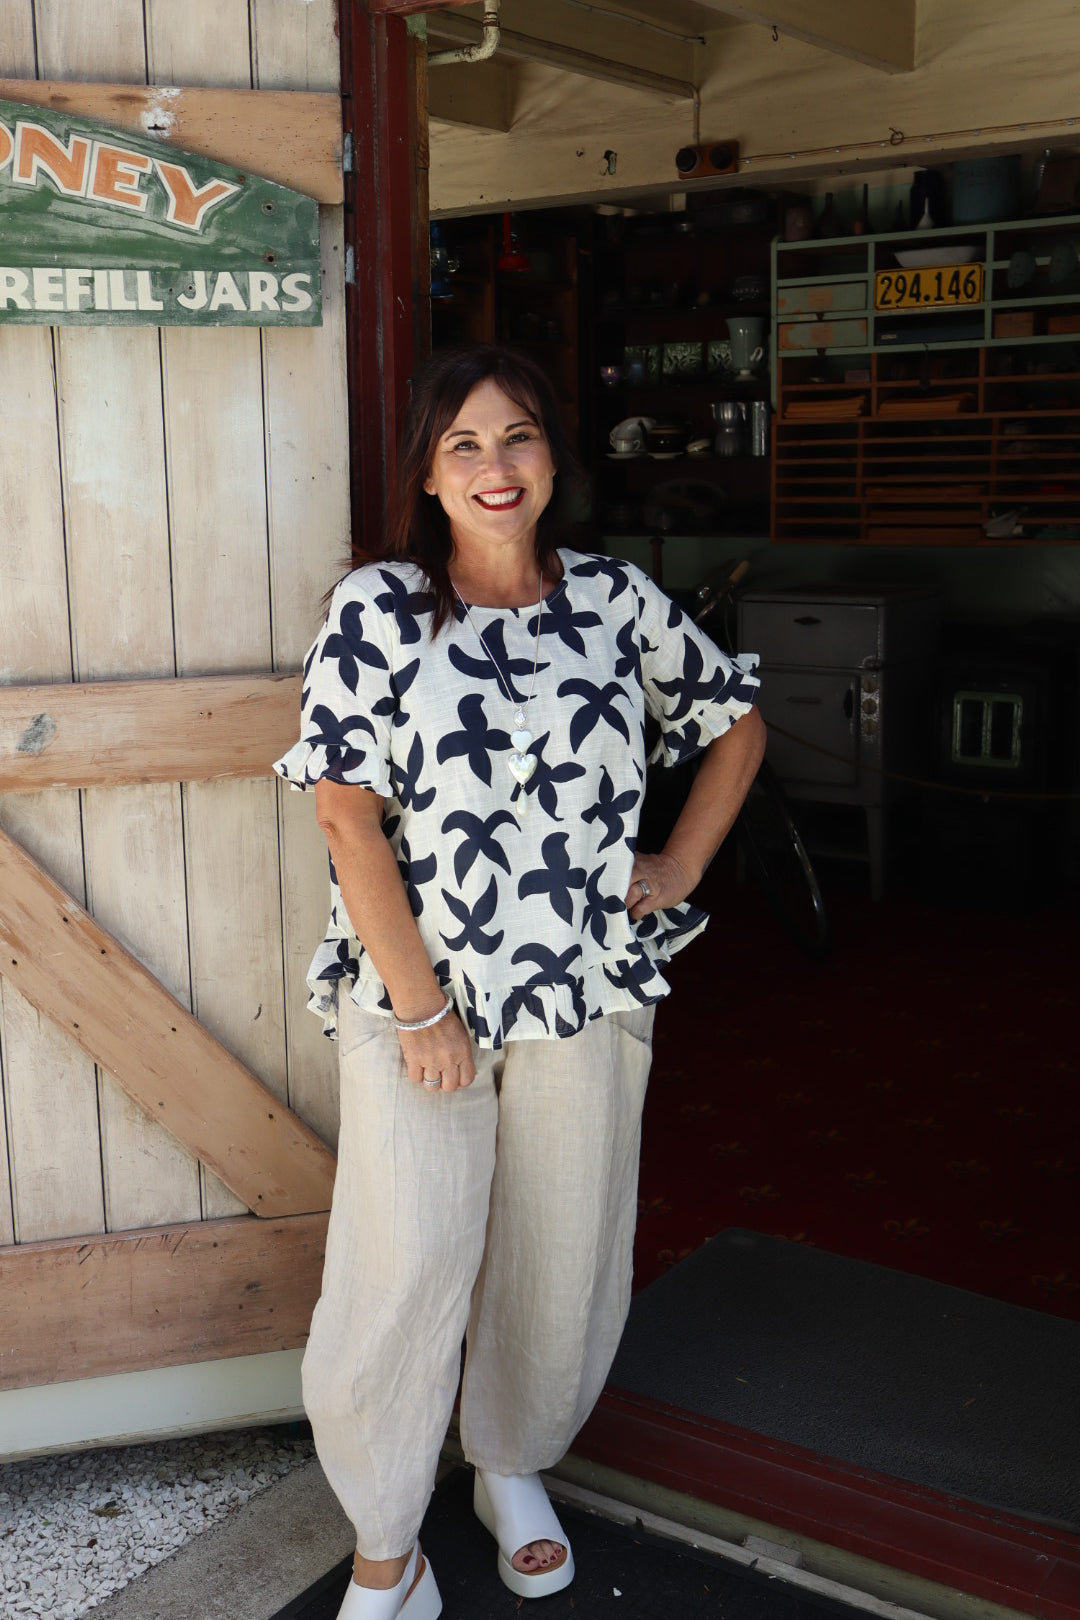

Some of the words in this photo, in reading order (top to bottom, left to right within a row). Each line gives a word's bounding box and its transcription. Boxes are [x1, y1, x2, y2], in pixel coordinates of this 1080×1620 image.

[0, 120, 242, 231] NEY
[0, 266, 163, 311] REFILL
[176, 270, 313, 312] JARS
[880, 269, 977, 306] 294.146
